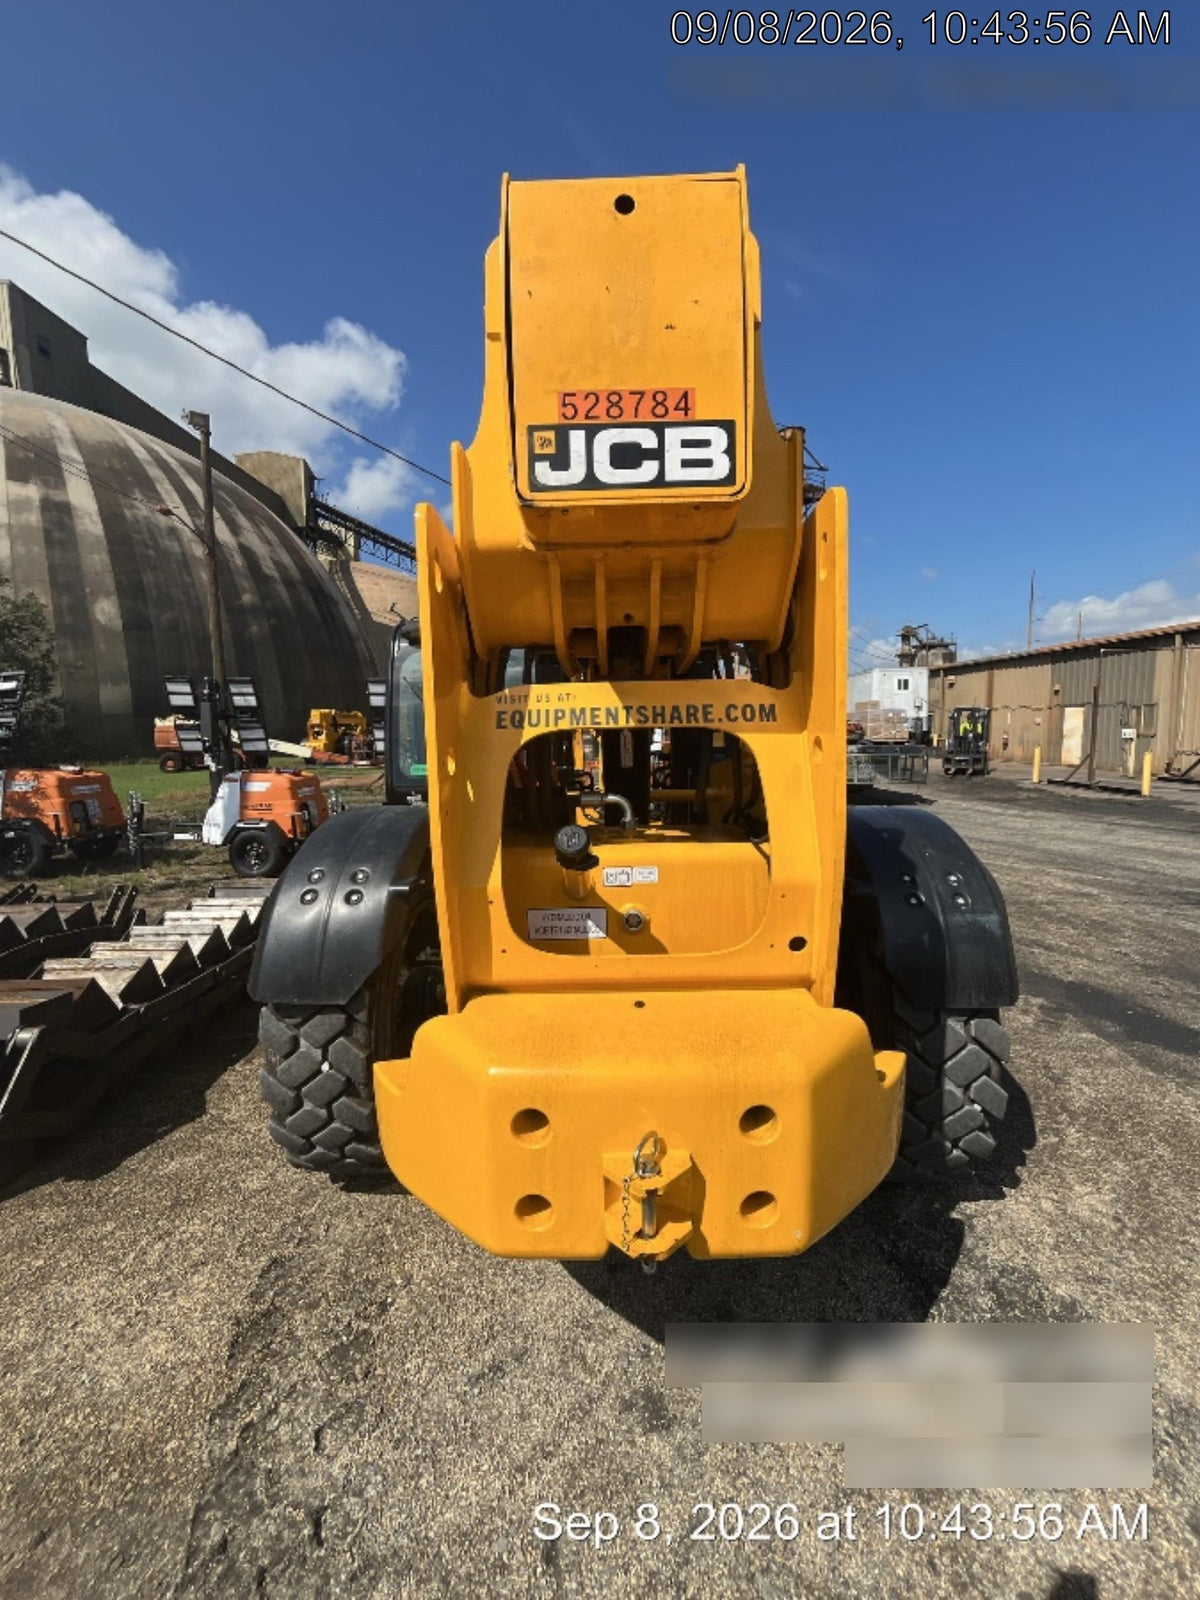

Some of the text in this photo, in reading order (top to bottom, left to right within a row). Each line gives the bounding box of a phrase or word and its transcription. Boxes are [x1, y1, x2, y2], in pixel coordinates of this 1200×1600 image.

[562, 390, 692, 421] 528784
[534, 426, 731, 487] JCB
[495, 694, 529, 705] VISIT
[536, 692, 551, 703] US
[495, 703, 778, 729] EQUIPMENTSHARE.COM
